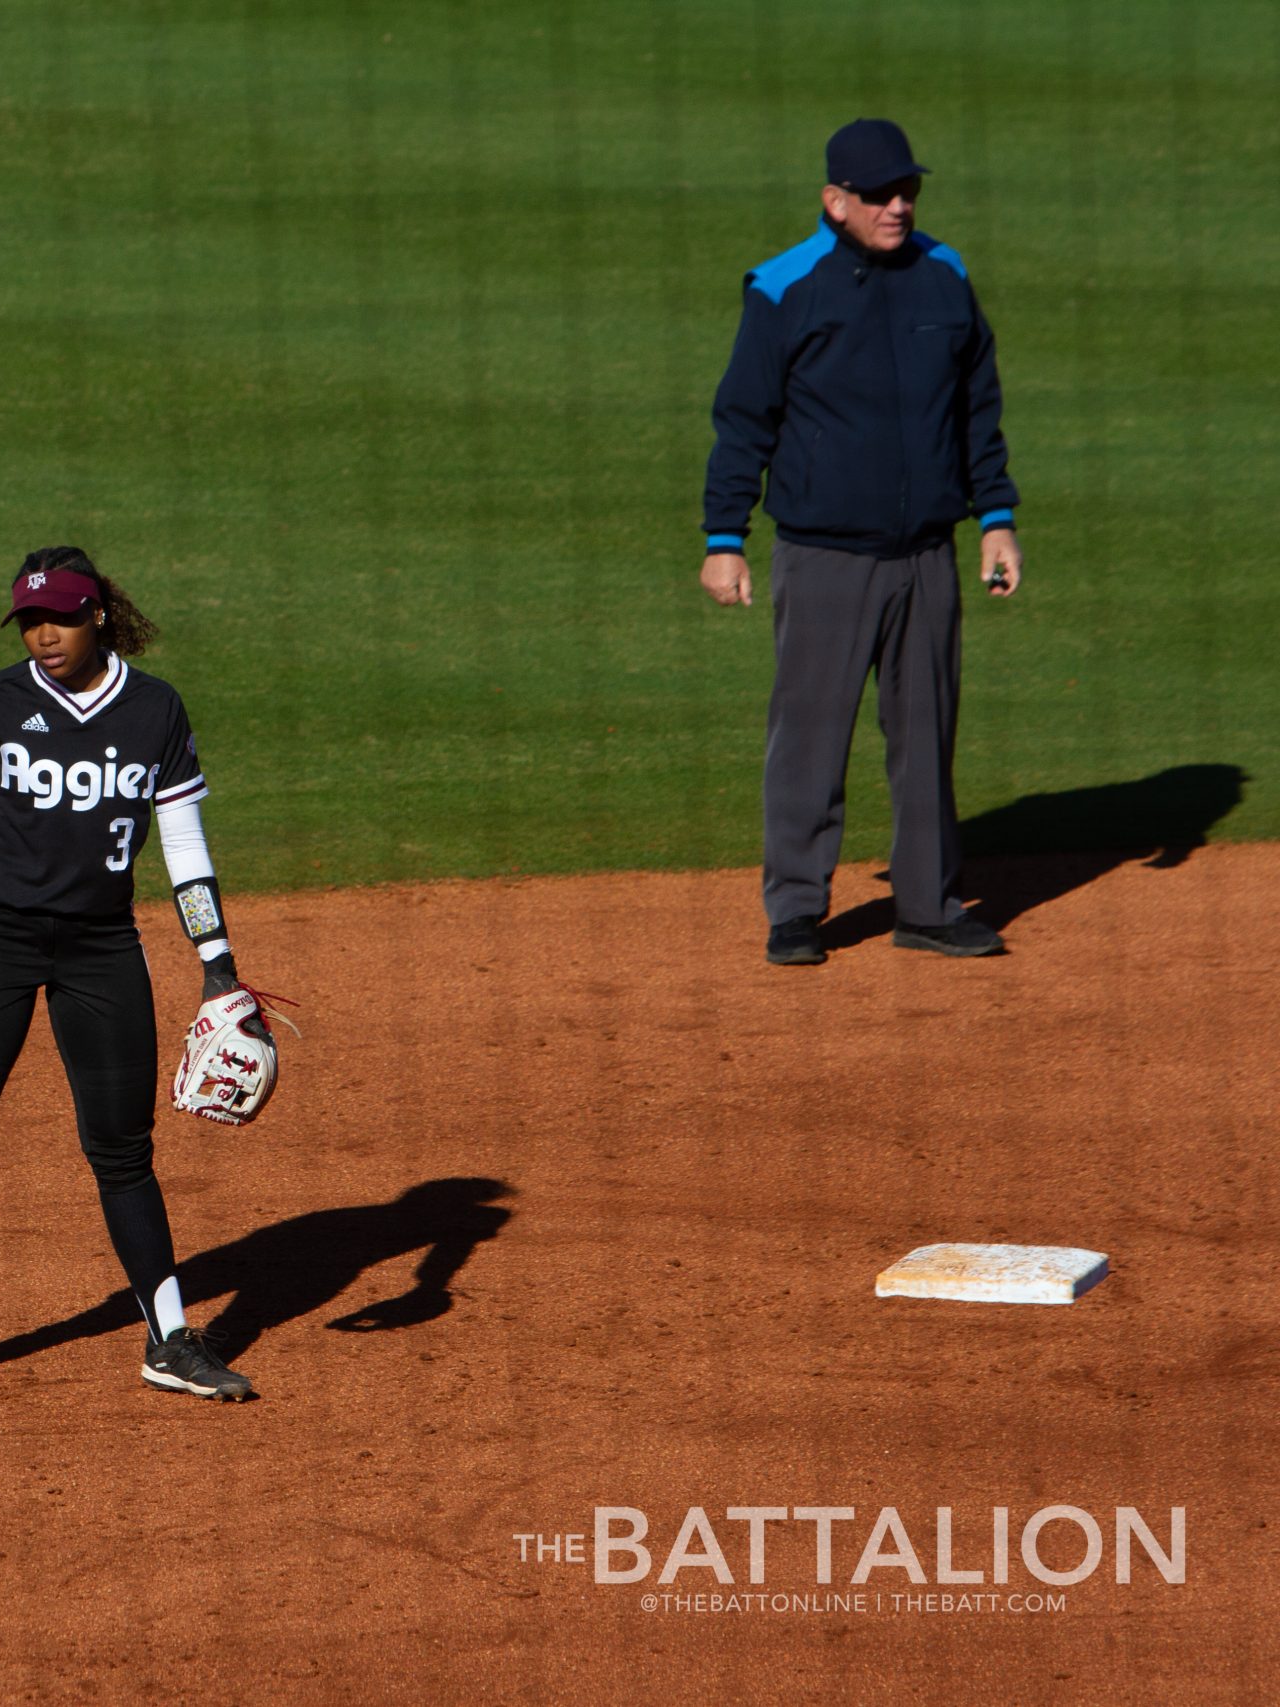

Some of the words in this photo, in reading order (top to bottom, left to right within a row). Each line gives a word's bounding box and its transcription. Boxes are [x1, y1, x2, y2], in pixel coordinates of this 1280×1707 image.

[21, 723, 50, 733] adidas
[0, 742, 160, 812] Aggies
[105, 817, 135, 872] 3
